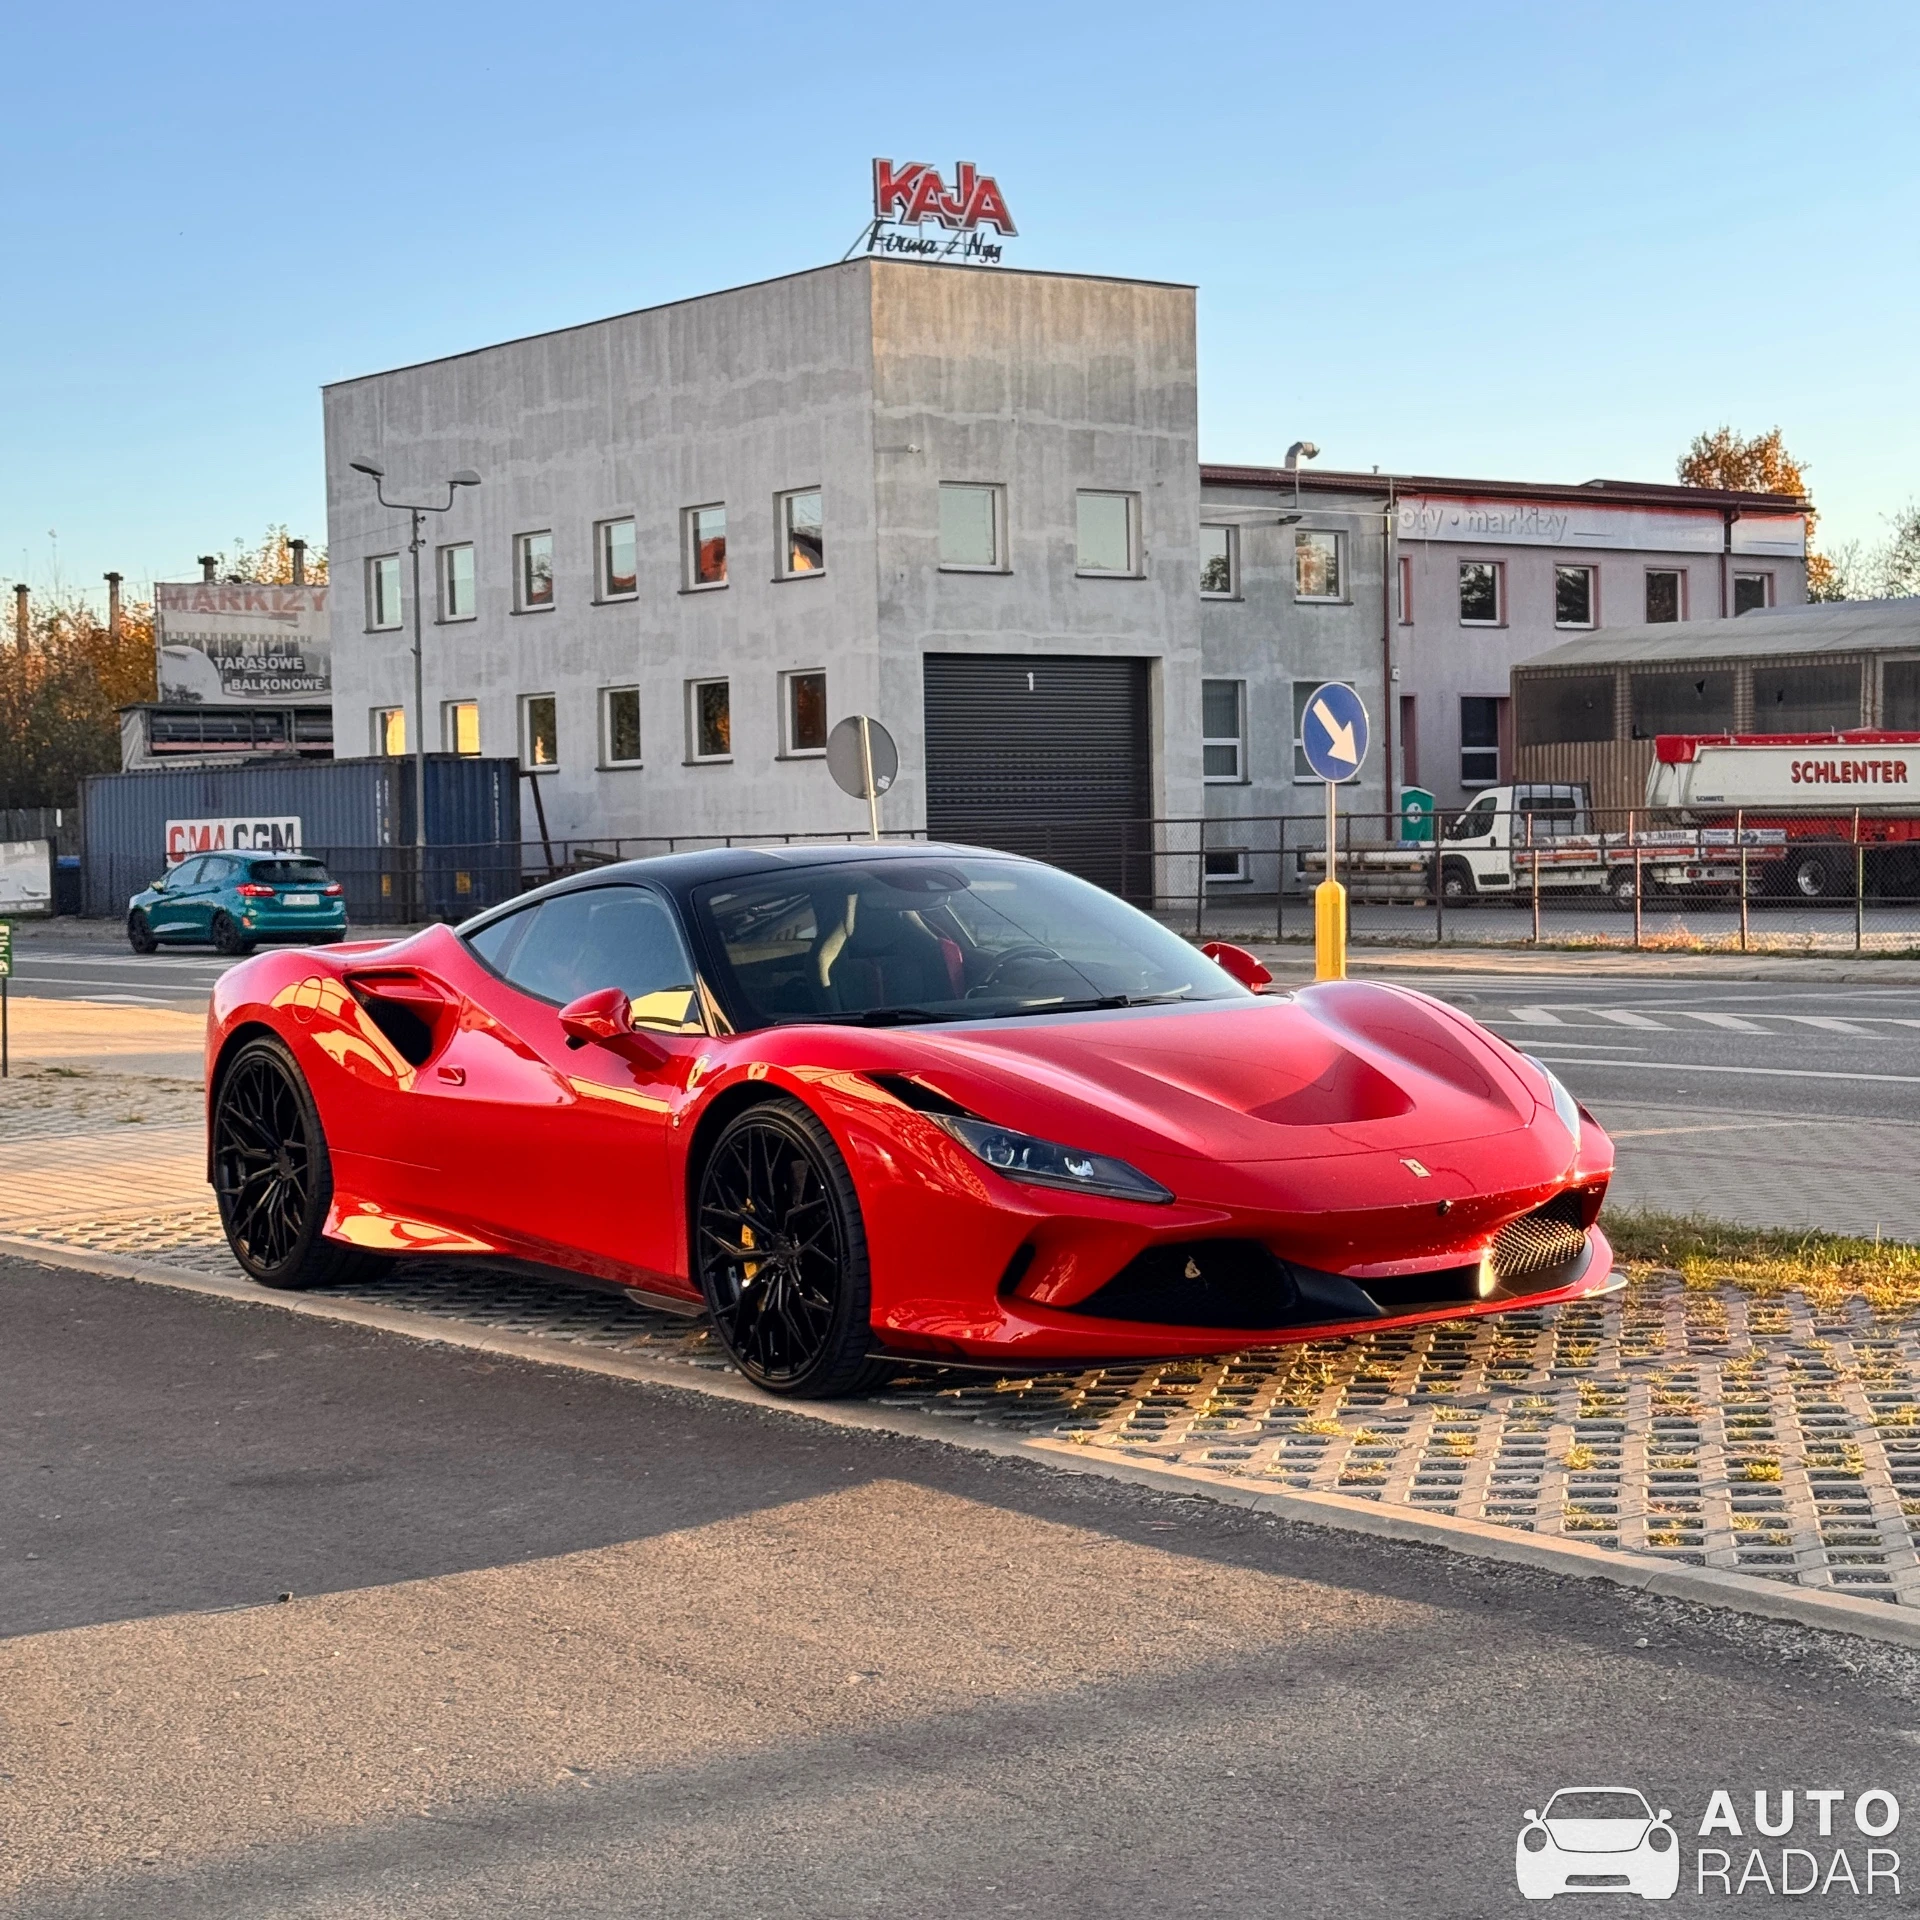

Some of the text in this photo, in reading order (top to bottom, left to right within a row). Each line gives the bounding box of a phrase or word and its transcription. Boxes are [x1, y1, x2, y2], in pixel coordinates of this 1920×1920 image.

[872, 158, 1019, 237] KAJA
[866, 220, 938, 255] Firma
[945, 241, 959, 255] z
[1464, 506, 1567, 543] markizy
[161, 586, 327, 612] MARKIZY
[214, 656, 304, 670] TARASOWE
[231, 678, 324, 691] BALKONOWE
[1026, 672, 1034, 691] 1
[1791, 761, 1908, 784] SCHLENTER
[169, 823, 294, 863] CMA CGM
